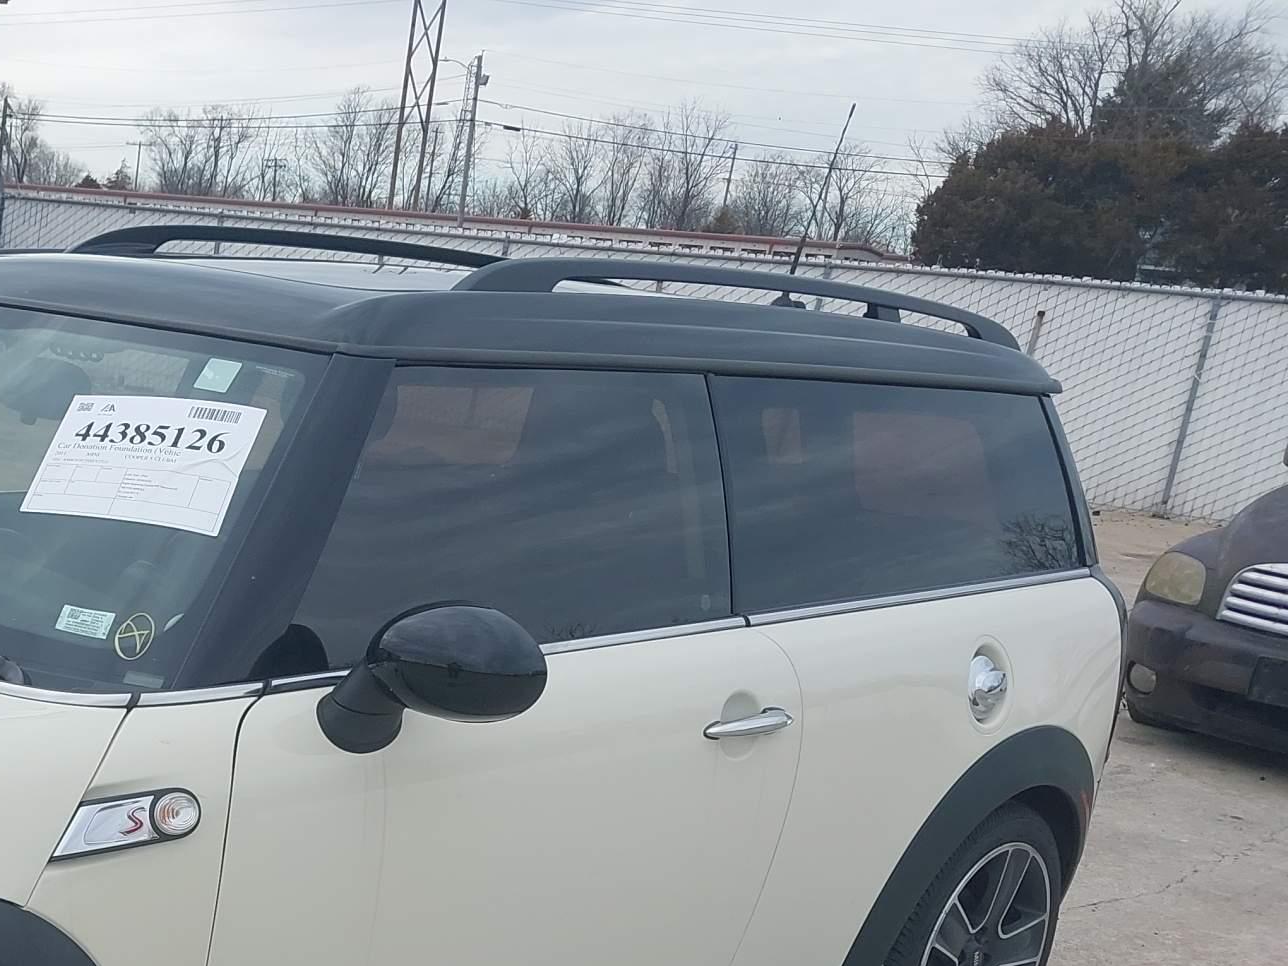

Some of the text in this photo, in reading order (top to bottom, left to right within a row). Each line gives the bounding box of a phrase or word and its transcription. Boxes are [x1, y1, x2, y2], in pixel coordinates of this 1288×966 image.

[57, 442, 72, 450] Car
[72, 442, 108, 452] Donation
[109, 444, 152, 455] Foundation
[74, 420, 232, 454] 44385126
[120, 806, 146, 836] S
